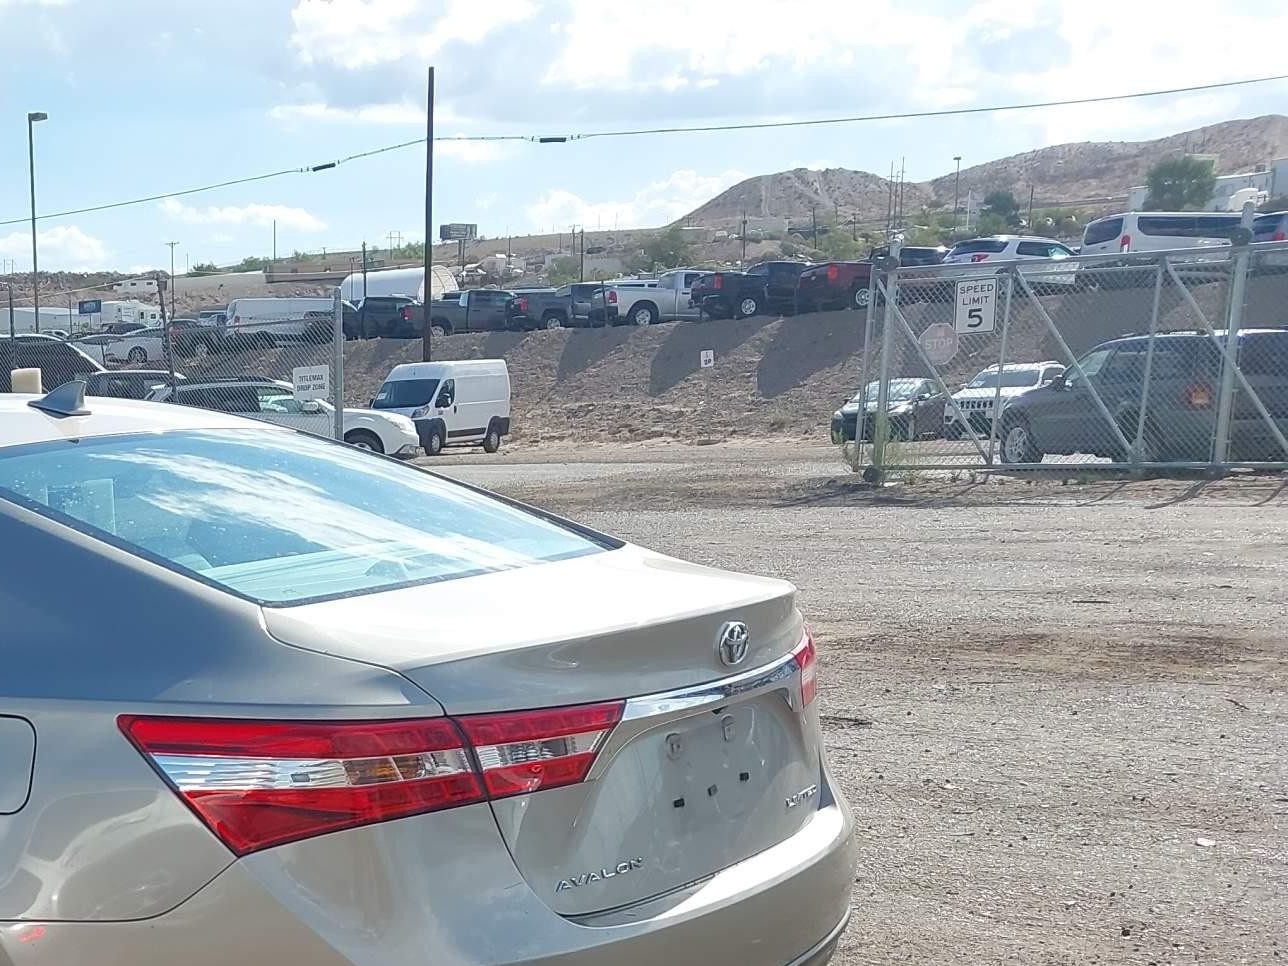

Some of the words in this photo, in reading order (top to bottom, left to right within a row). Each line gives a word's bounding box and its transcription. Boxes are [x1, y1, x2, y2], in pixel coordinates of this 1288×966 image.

[959, 284, 994, 295] SPEED
[962, 296, 990, 306] LIMIT
[967, 308, 983, 328] 5
[924, 337, 953, 350] STOP
[555, 857, 643, 893] AVALON
